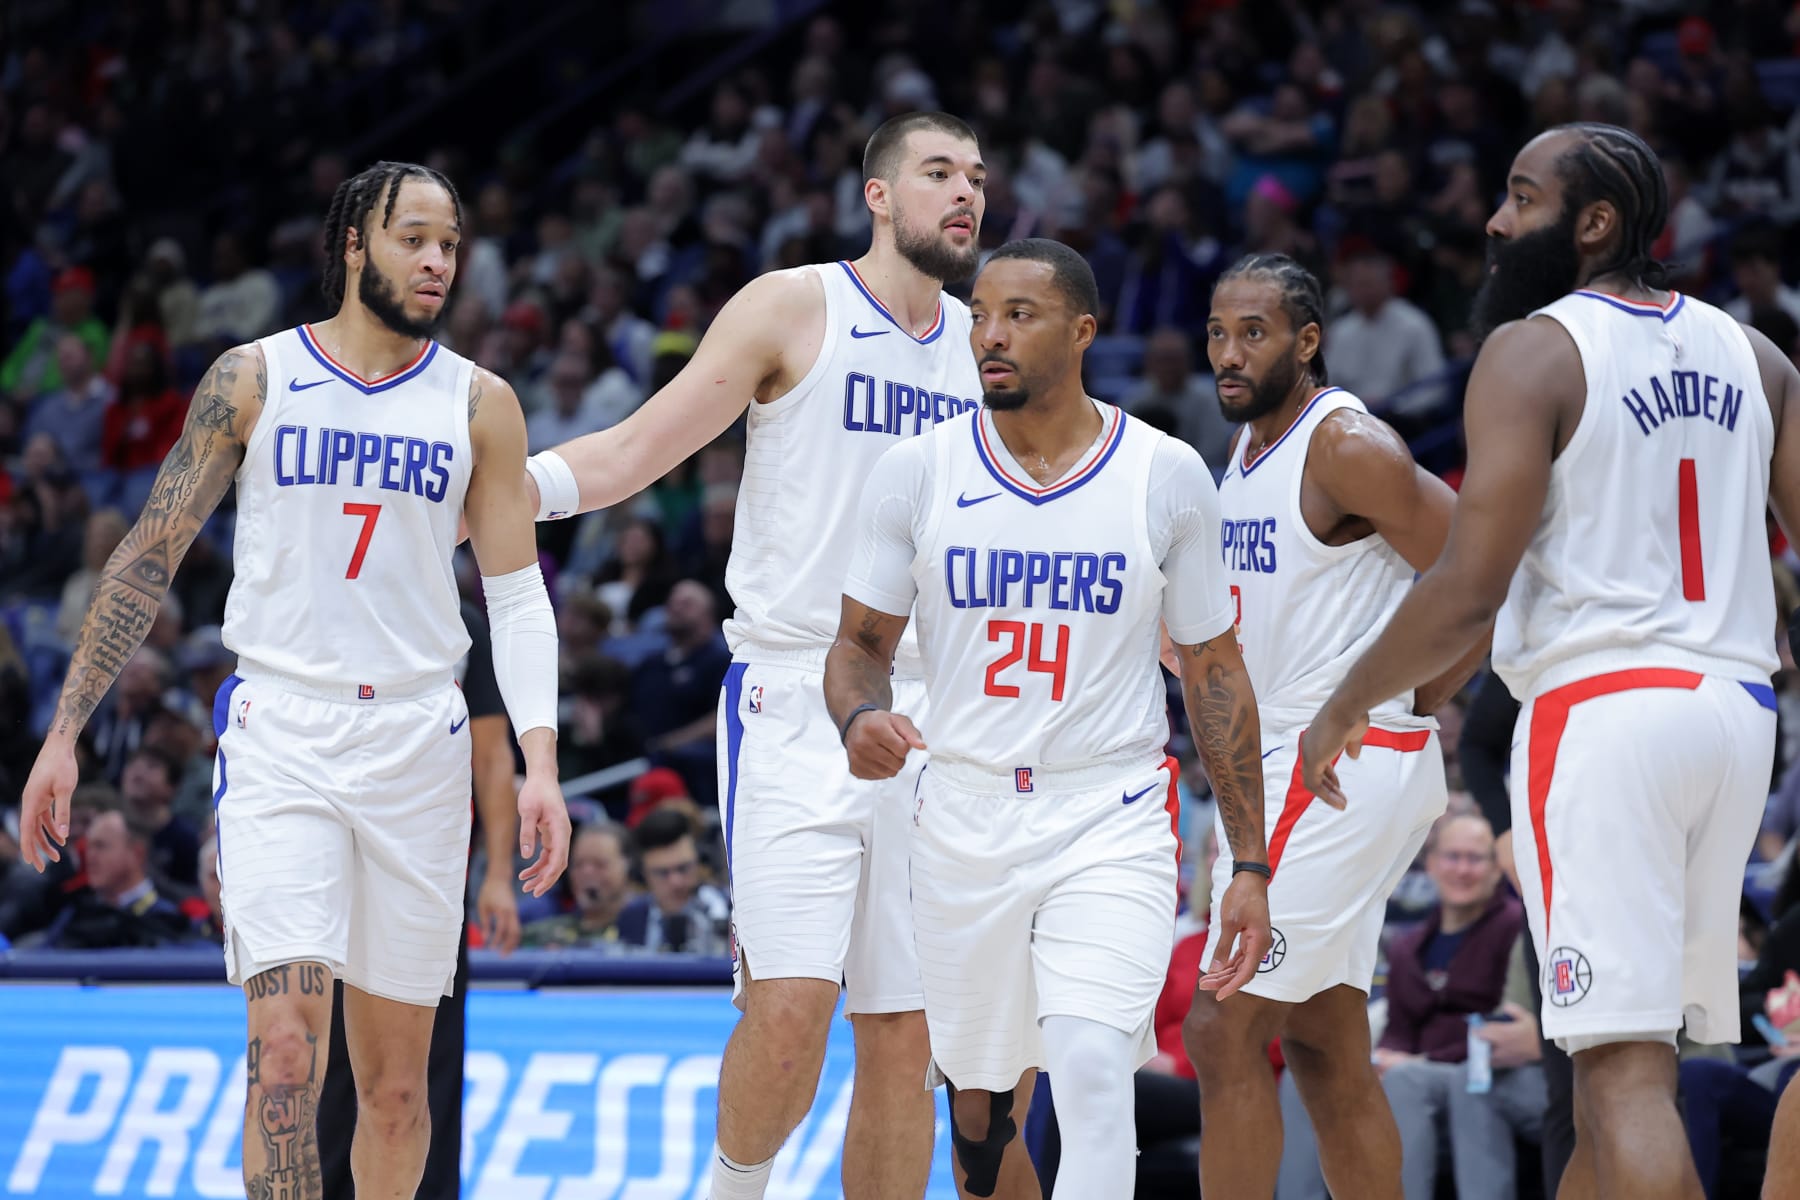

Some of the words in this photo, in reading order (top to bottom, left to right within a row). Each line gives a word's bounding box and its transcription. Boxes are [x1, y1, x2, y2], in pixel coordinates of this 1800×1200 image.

[843, 371, 980, 436] CLIPPE
[273, 424, 454, 503] CLIPPERS
[343, 502, 383, 580] 7
[1678, 458, 1706, 602] 1
[944, 545, 1127, 615] CLIPPERS
[984, 619, 1071, 702] 24
[300, 964, 325, 997] US
